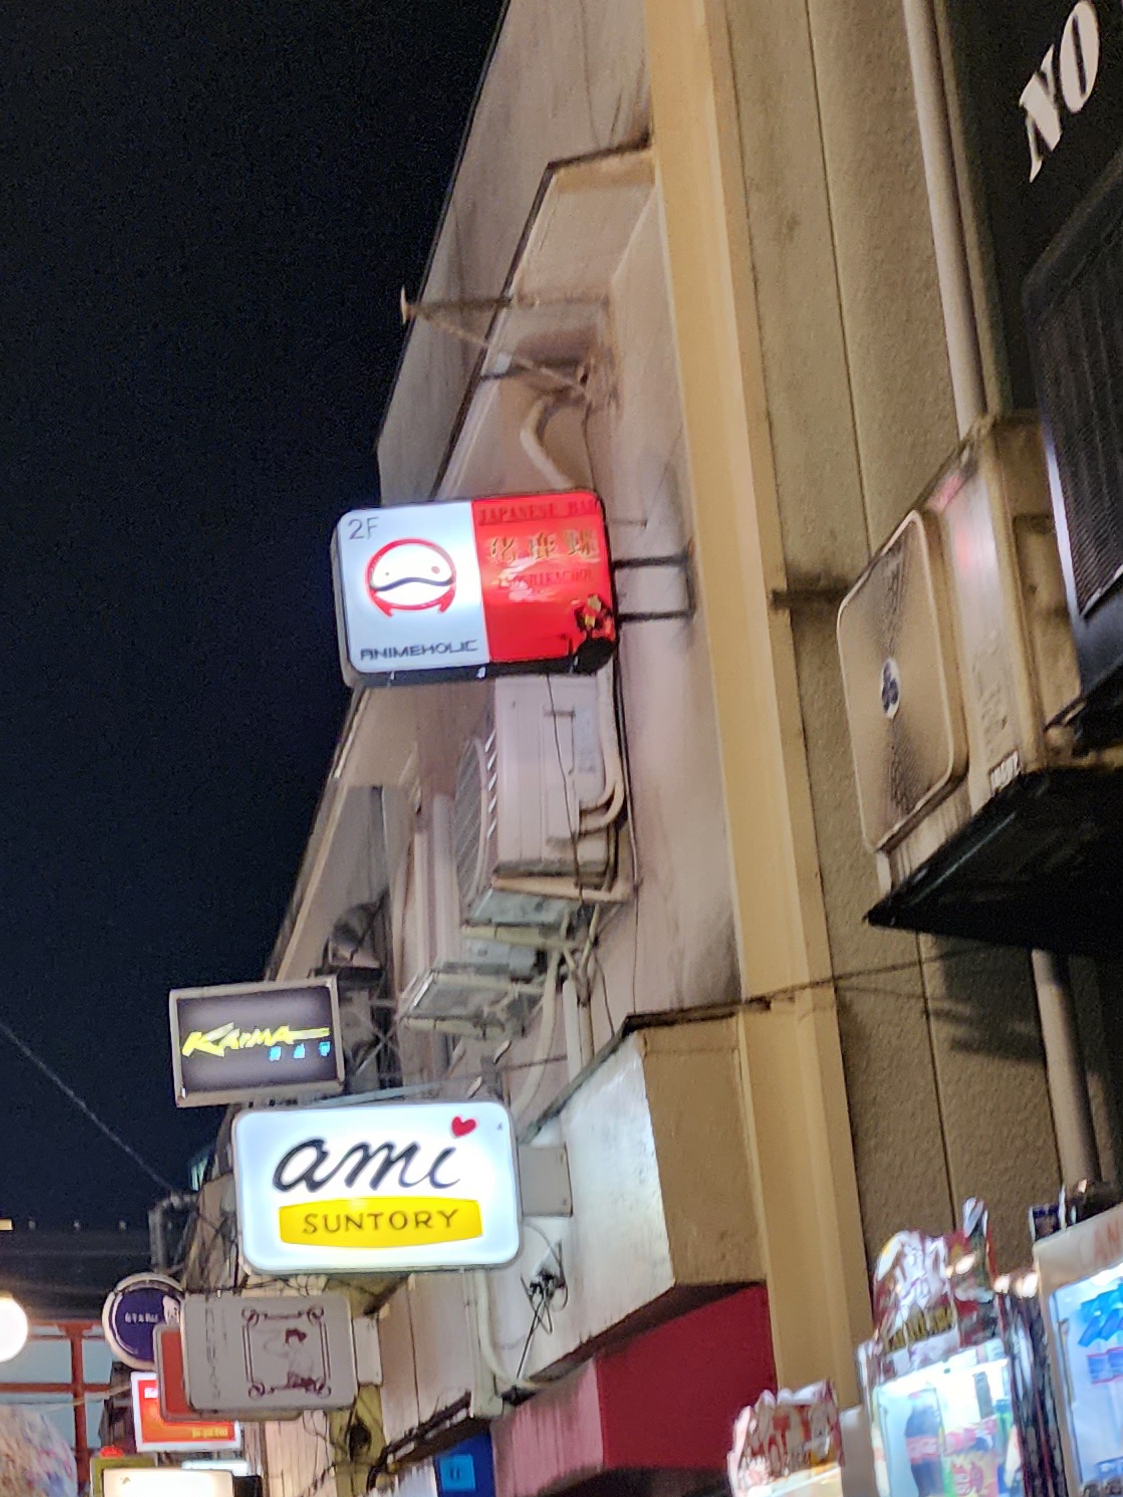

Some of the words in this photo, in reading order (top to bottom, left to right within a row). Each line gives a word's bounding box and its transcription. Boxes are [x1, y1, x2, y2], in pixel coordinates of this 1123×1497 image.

[347, 516, 379, 540] 2F
[360, 639, 479, 661] ANIMEHOLIC
[273, 1137, 462, 1194] ami
[302, 1209, 458, 1235] SUNTORY
